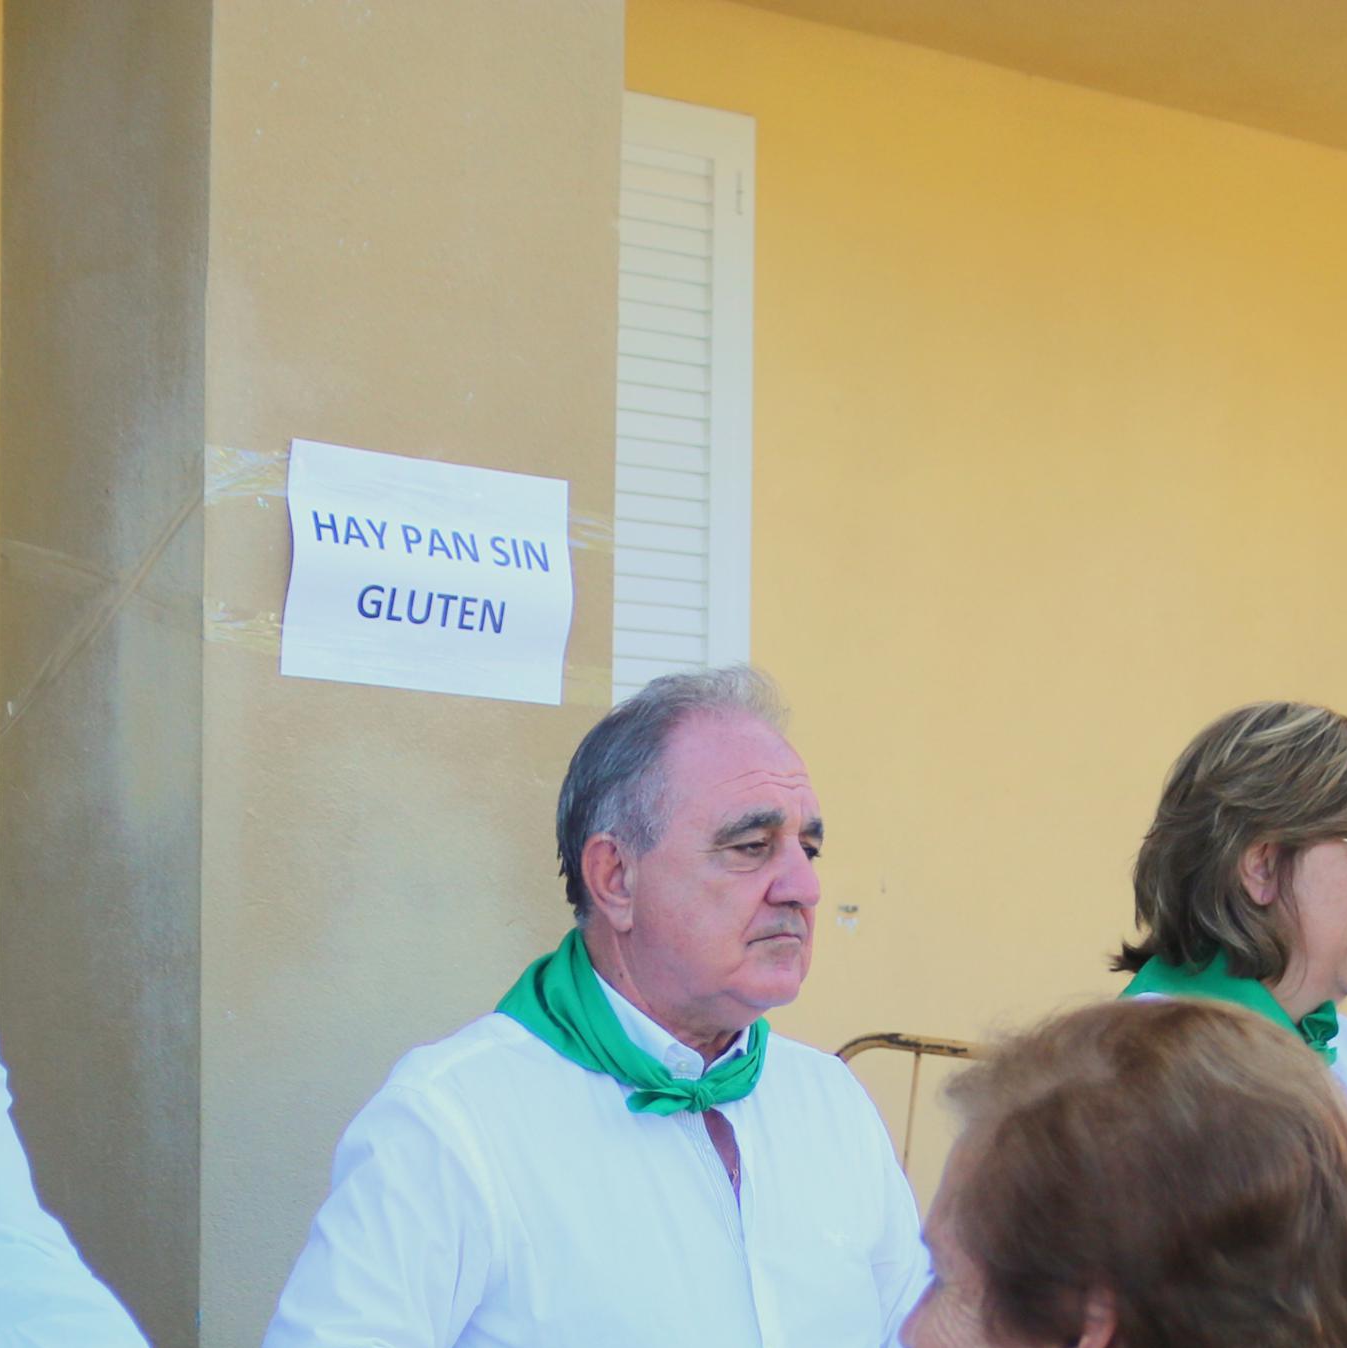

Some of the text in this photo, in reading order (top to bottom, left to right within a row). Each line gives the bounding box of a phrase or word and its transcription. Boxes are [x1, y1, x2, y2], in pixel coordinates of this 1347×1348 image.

[312, 510, 550, 573] HAY PAN SIN
[357, 584, 506, 634] GLUTEN
